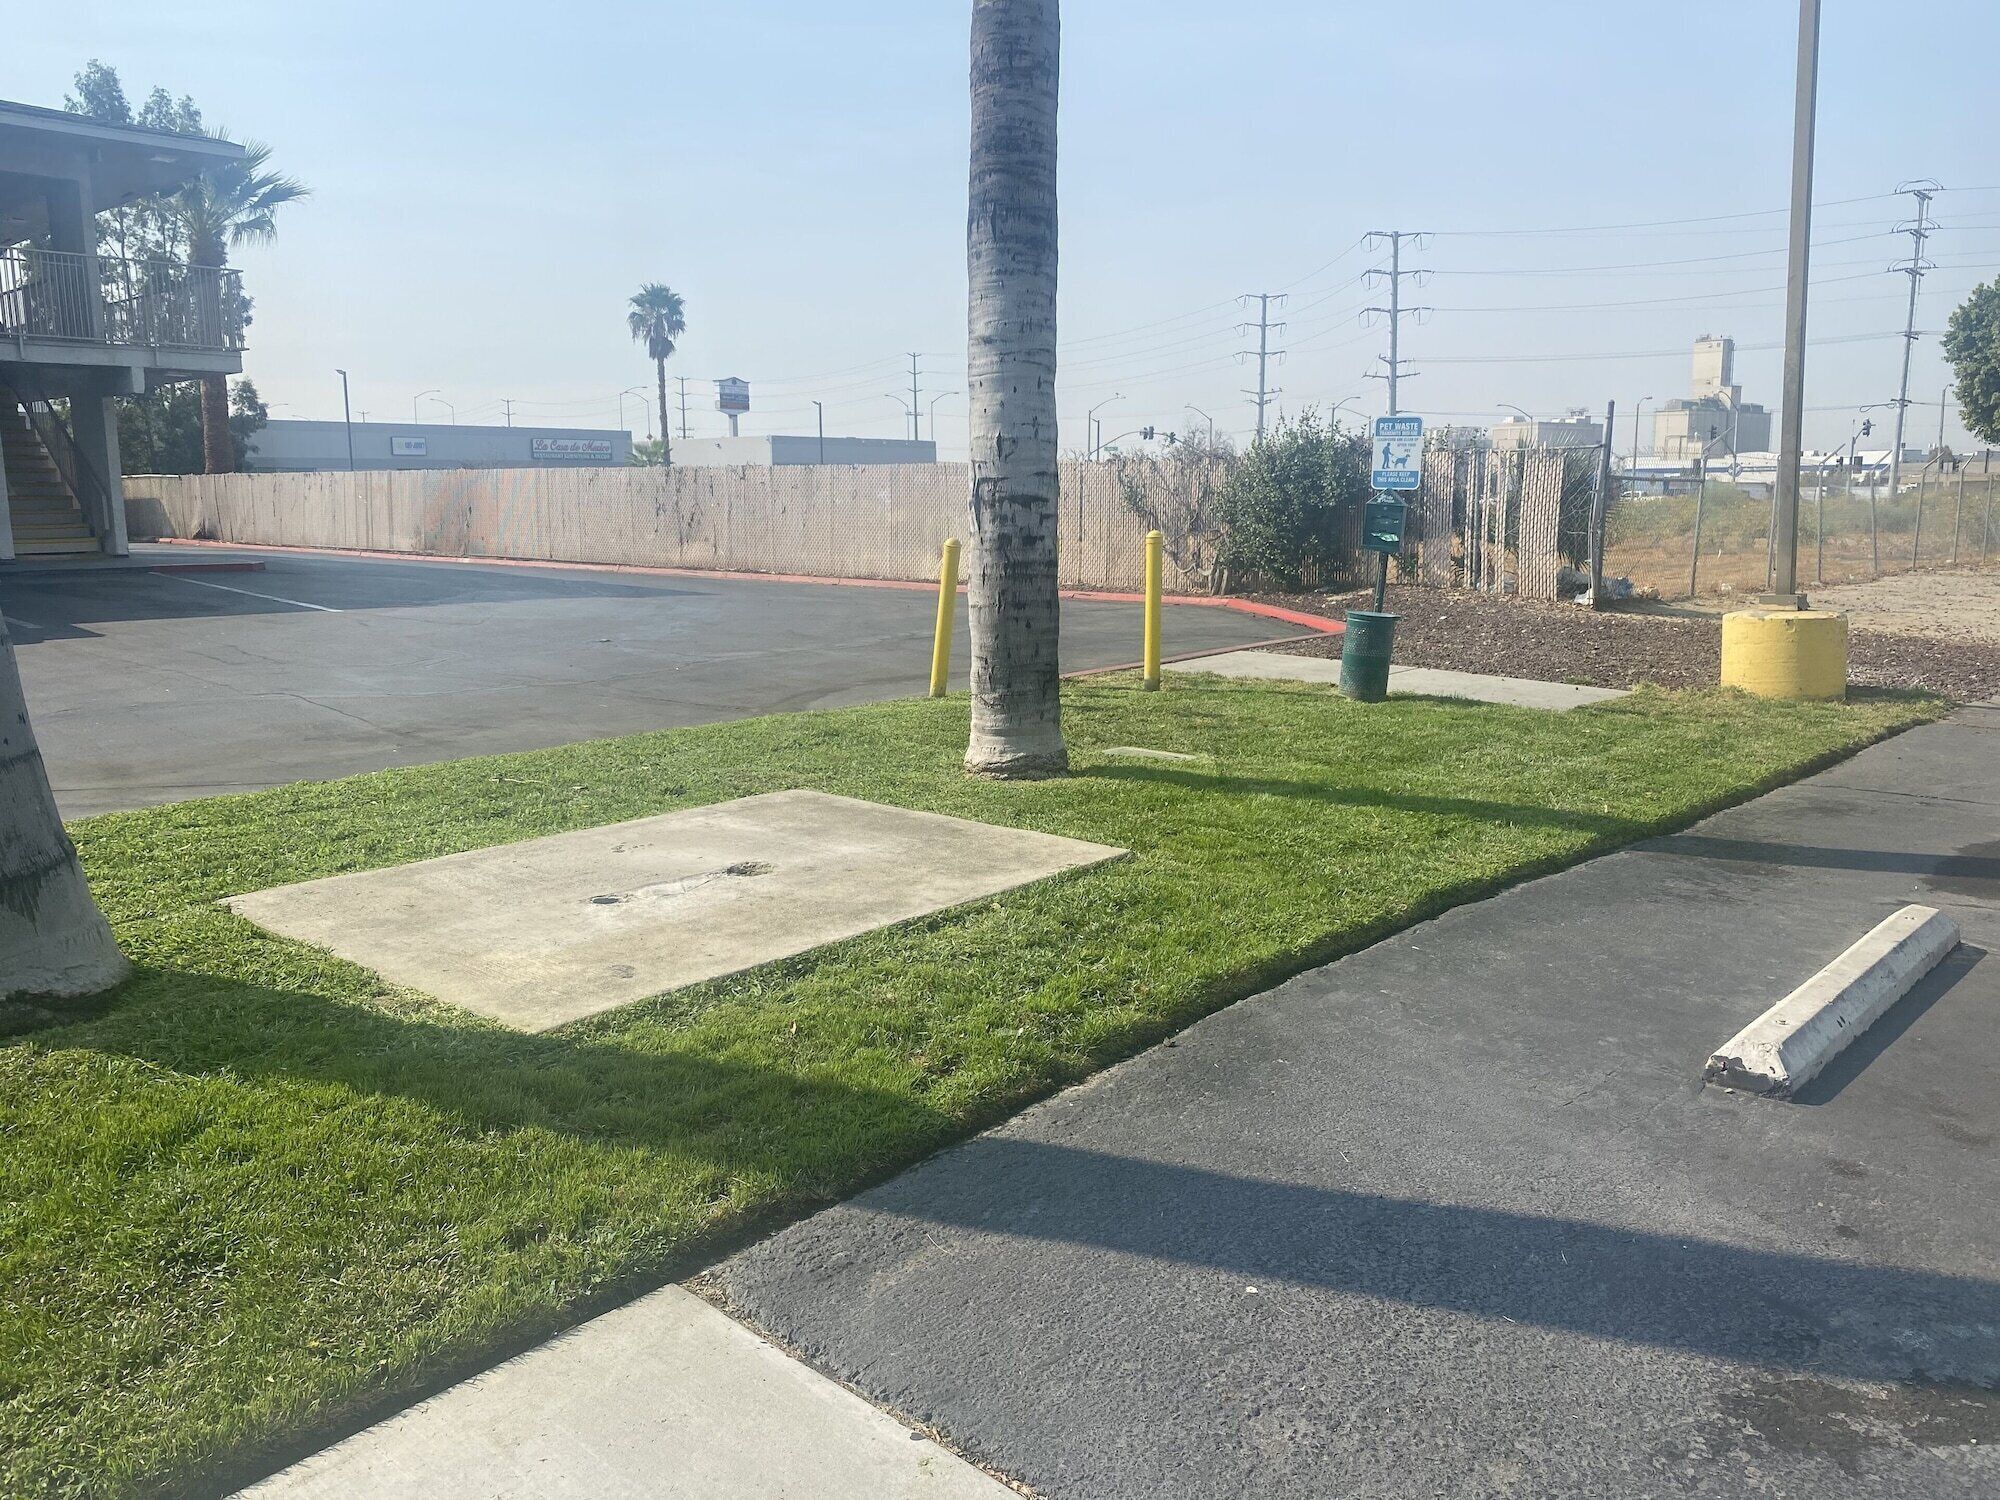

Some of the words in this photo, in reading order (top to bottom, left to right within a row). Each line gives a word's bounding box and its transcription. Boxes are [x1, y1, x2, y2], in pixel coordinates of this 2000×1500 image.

[1379, 422, 1393, 430] PET
[1395, 422, 1418, 430] WASTE
[535, 439, 549, 451] La
[551, 439, 569, 451] Casa
[582, 440, 609, 452] Mexico
